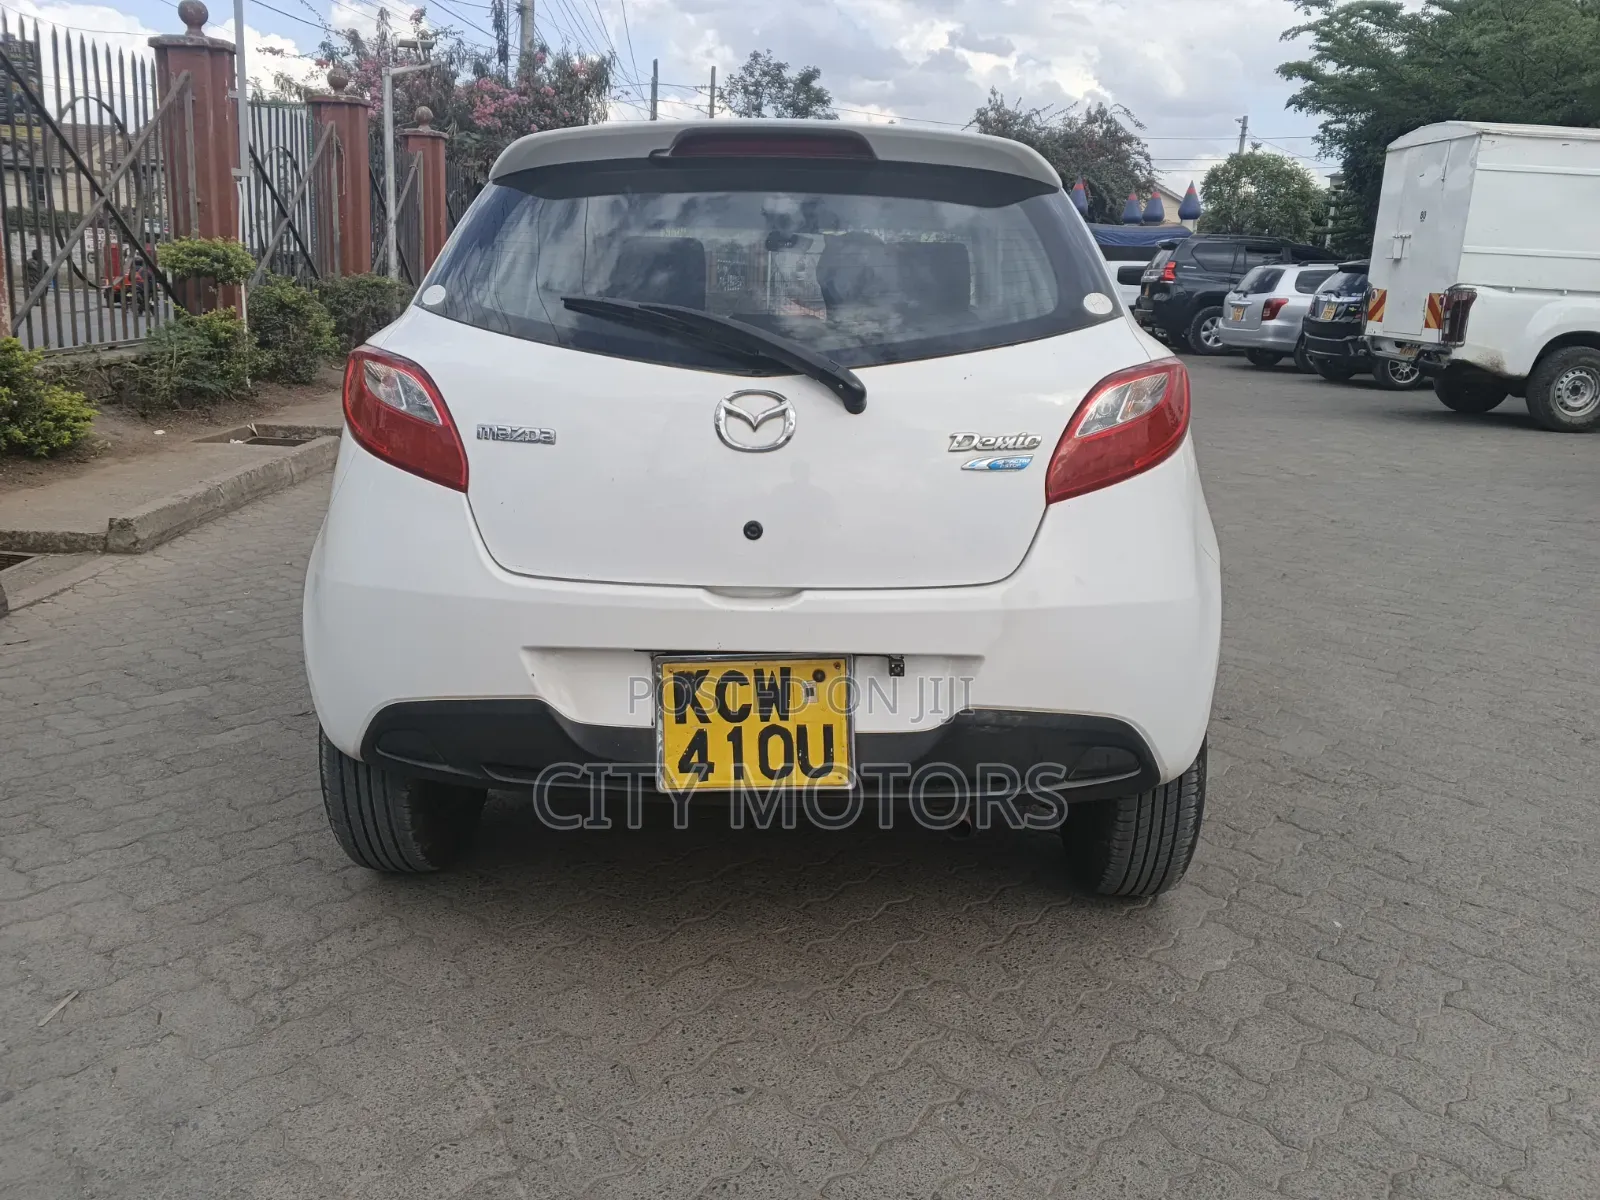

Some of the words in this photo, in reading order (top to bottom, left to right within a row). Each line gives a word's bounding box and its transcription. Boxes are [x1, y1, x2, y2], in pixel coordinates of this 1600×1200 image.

[948, 432, 1042, 452] Demio
[673, 667, 791, 724] KCW
[678, 724, 834, 782] 410U
